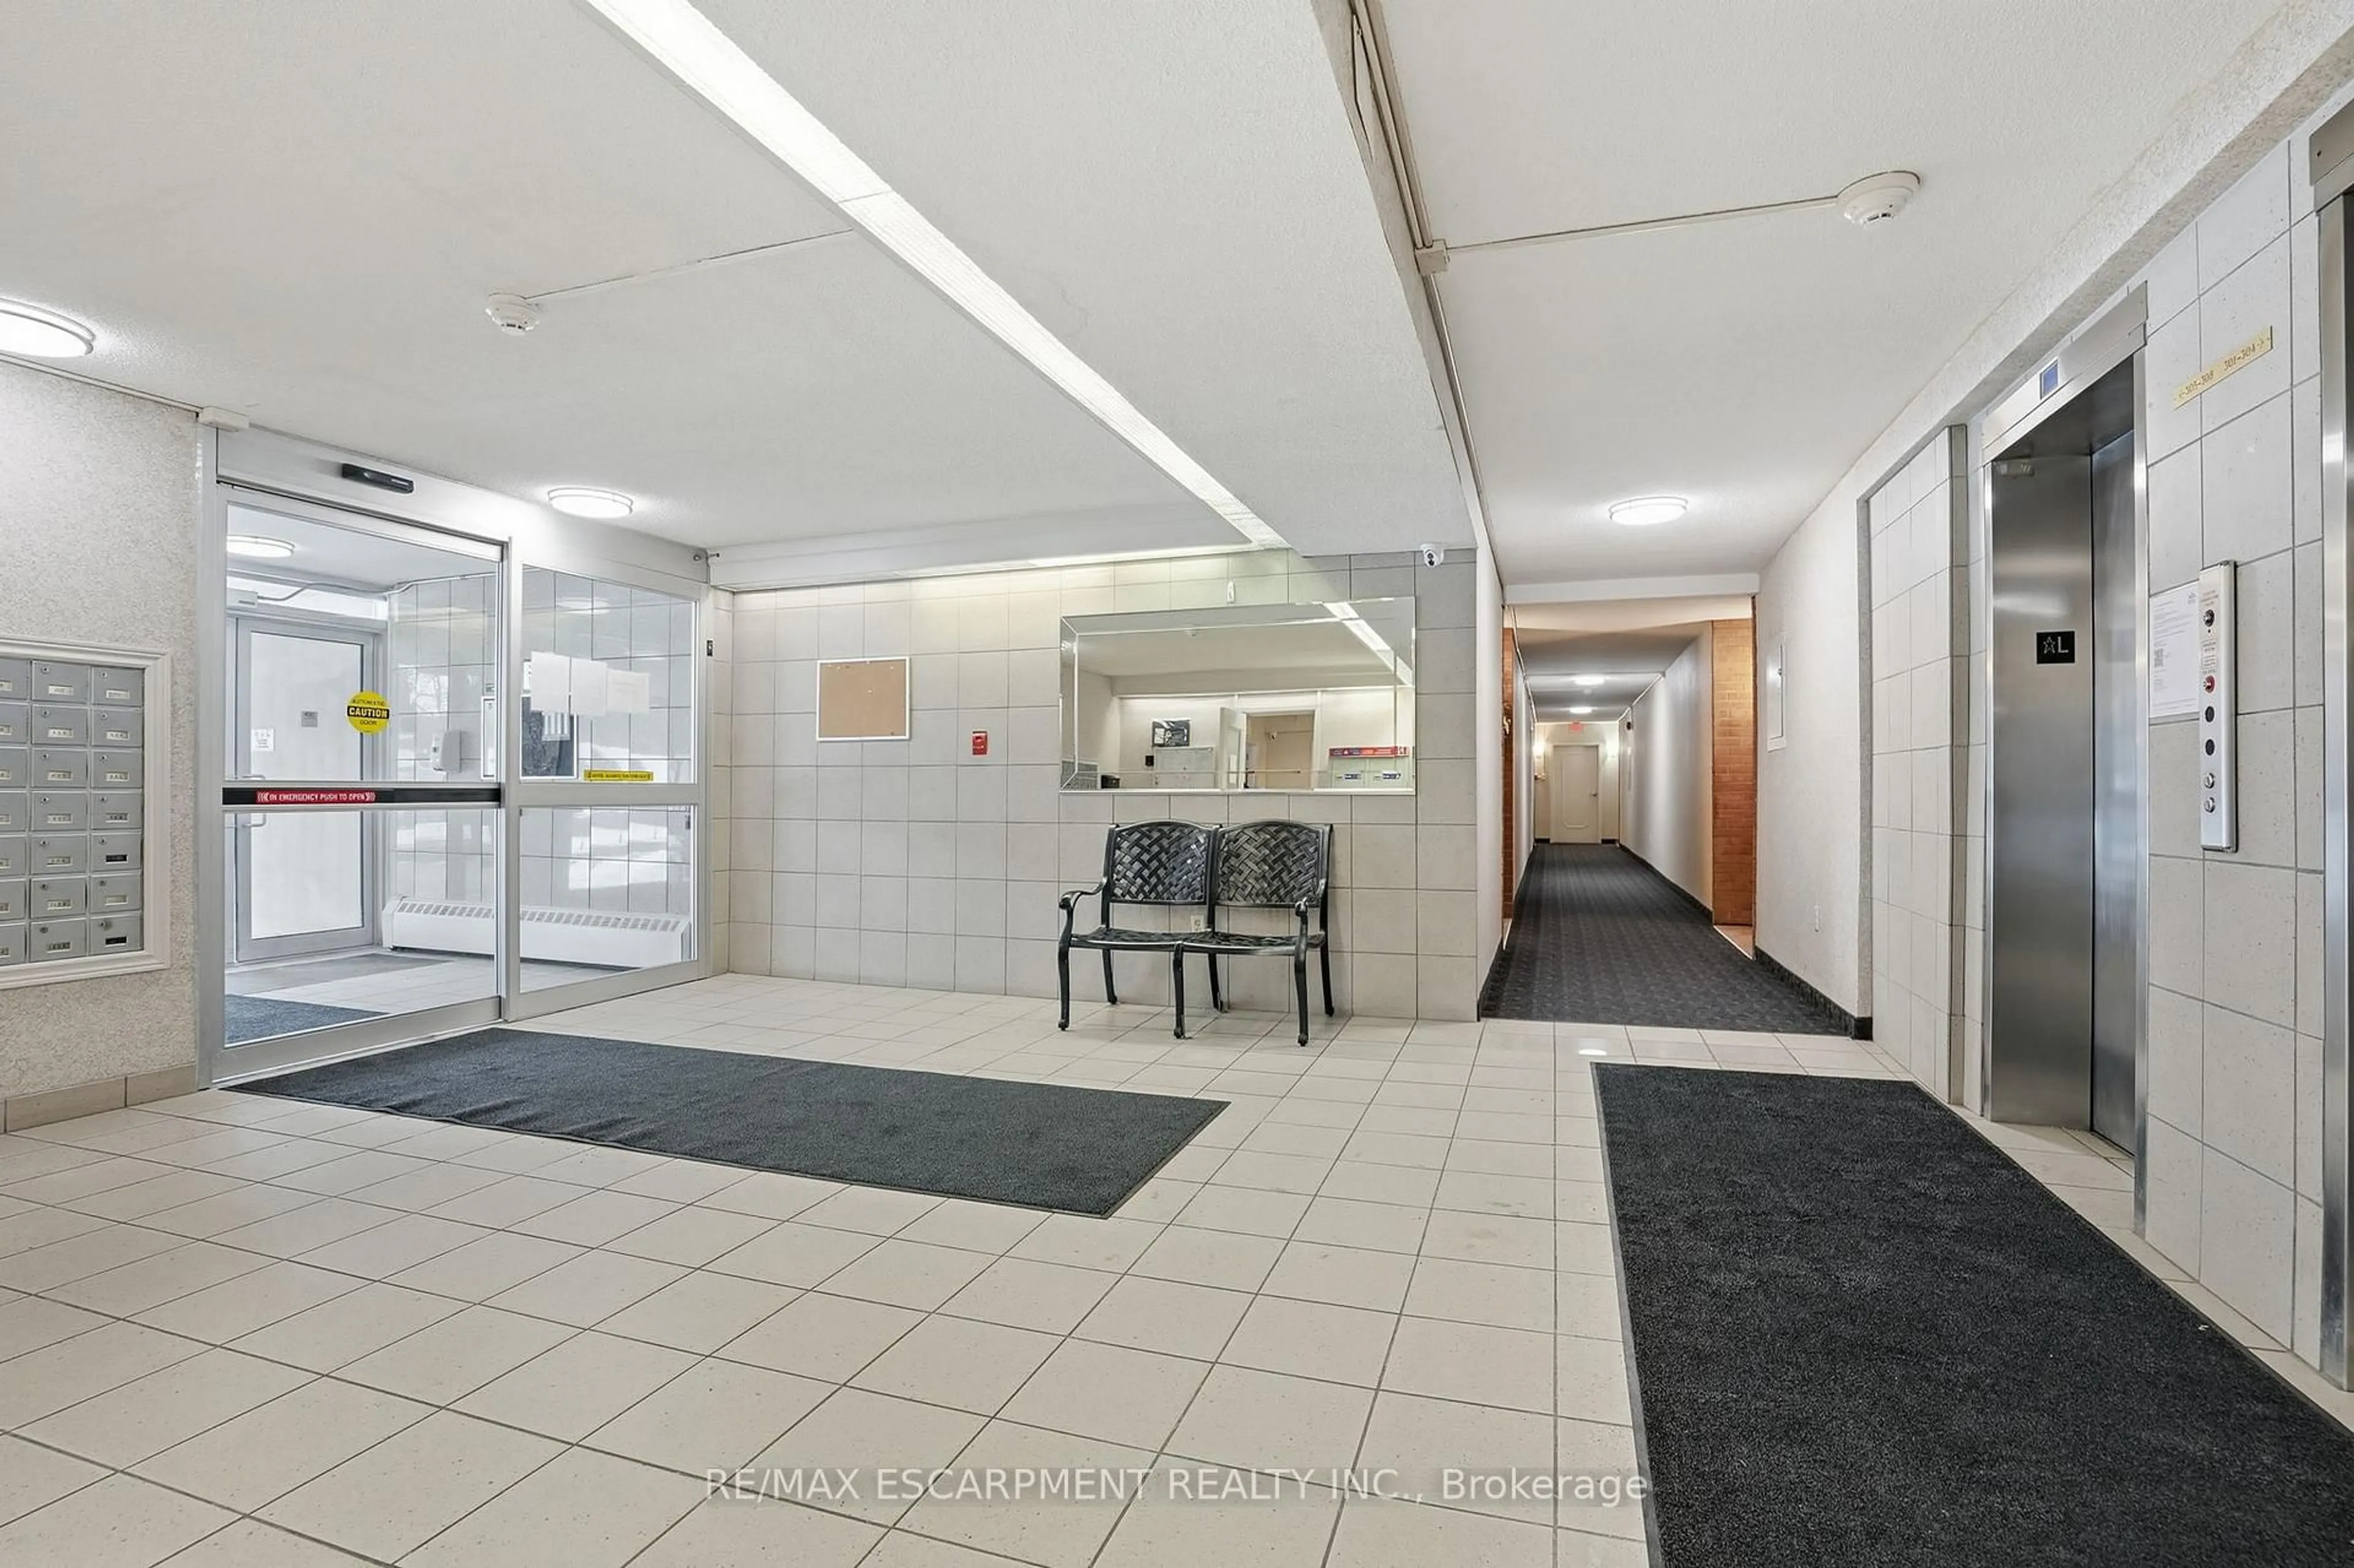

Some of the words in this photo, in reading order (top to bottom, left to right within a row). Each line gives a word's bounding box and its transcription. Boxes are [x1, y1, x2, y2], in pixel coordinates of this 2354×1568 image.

[2223, 343, 2256, 371] 301-304
[349, 707, 388, 718] CAUTION
[279, 793, 318, 802] EMERGENCY
